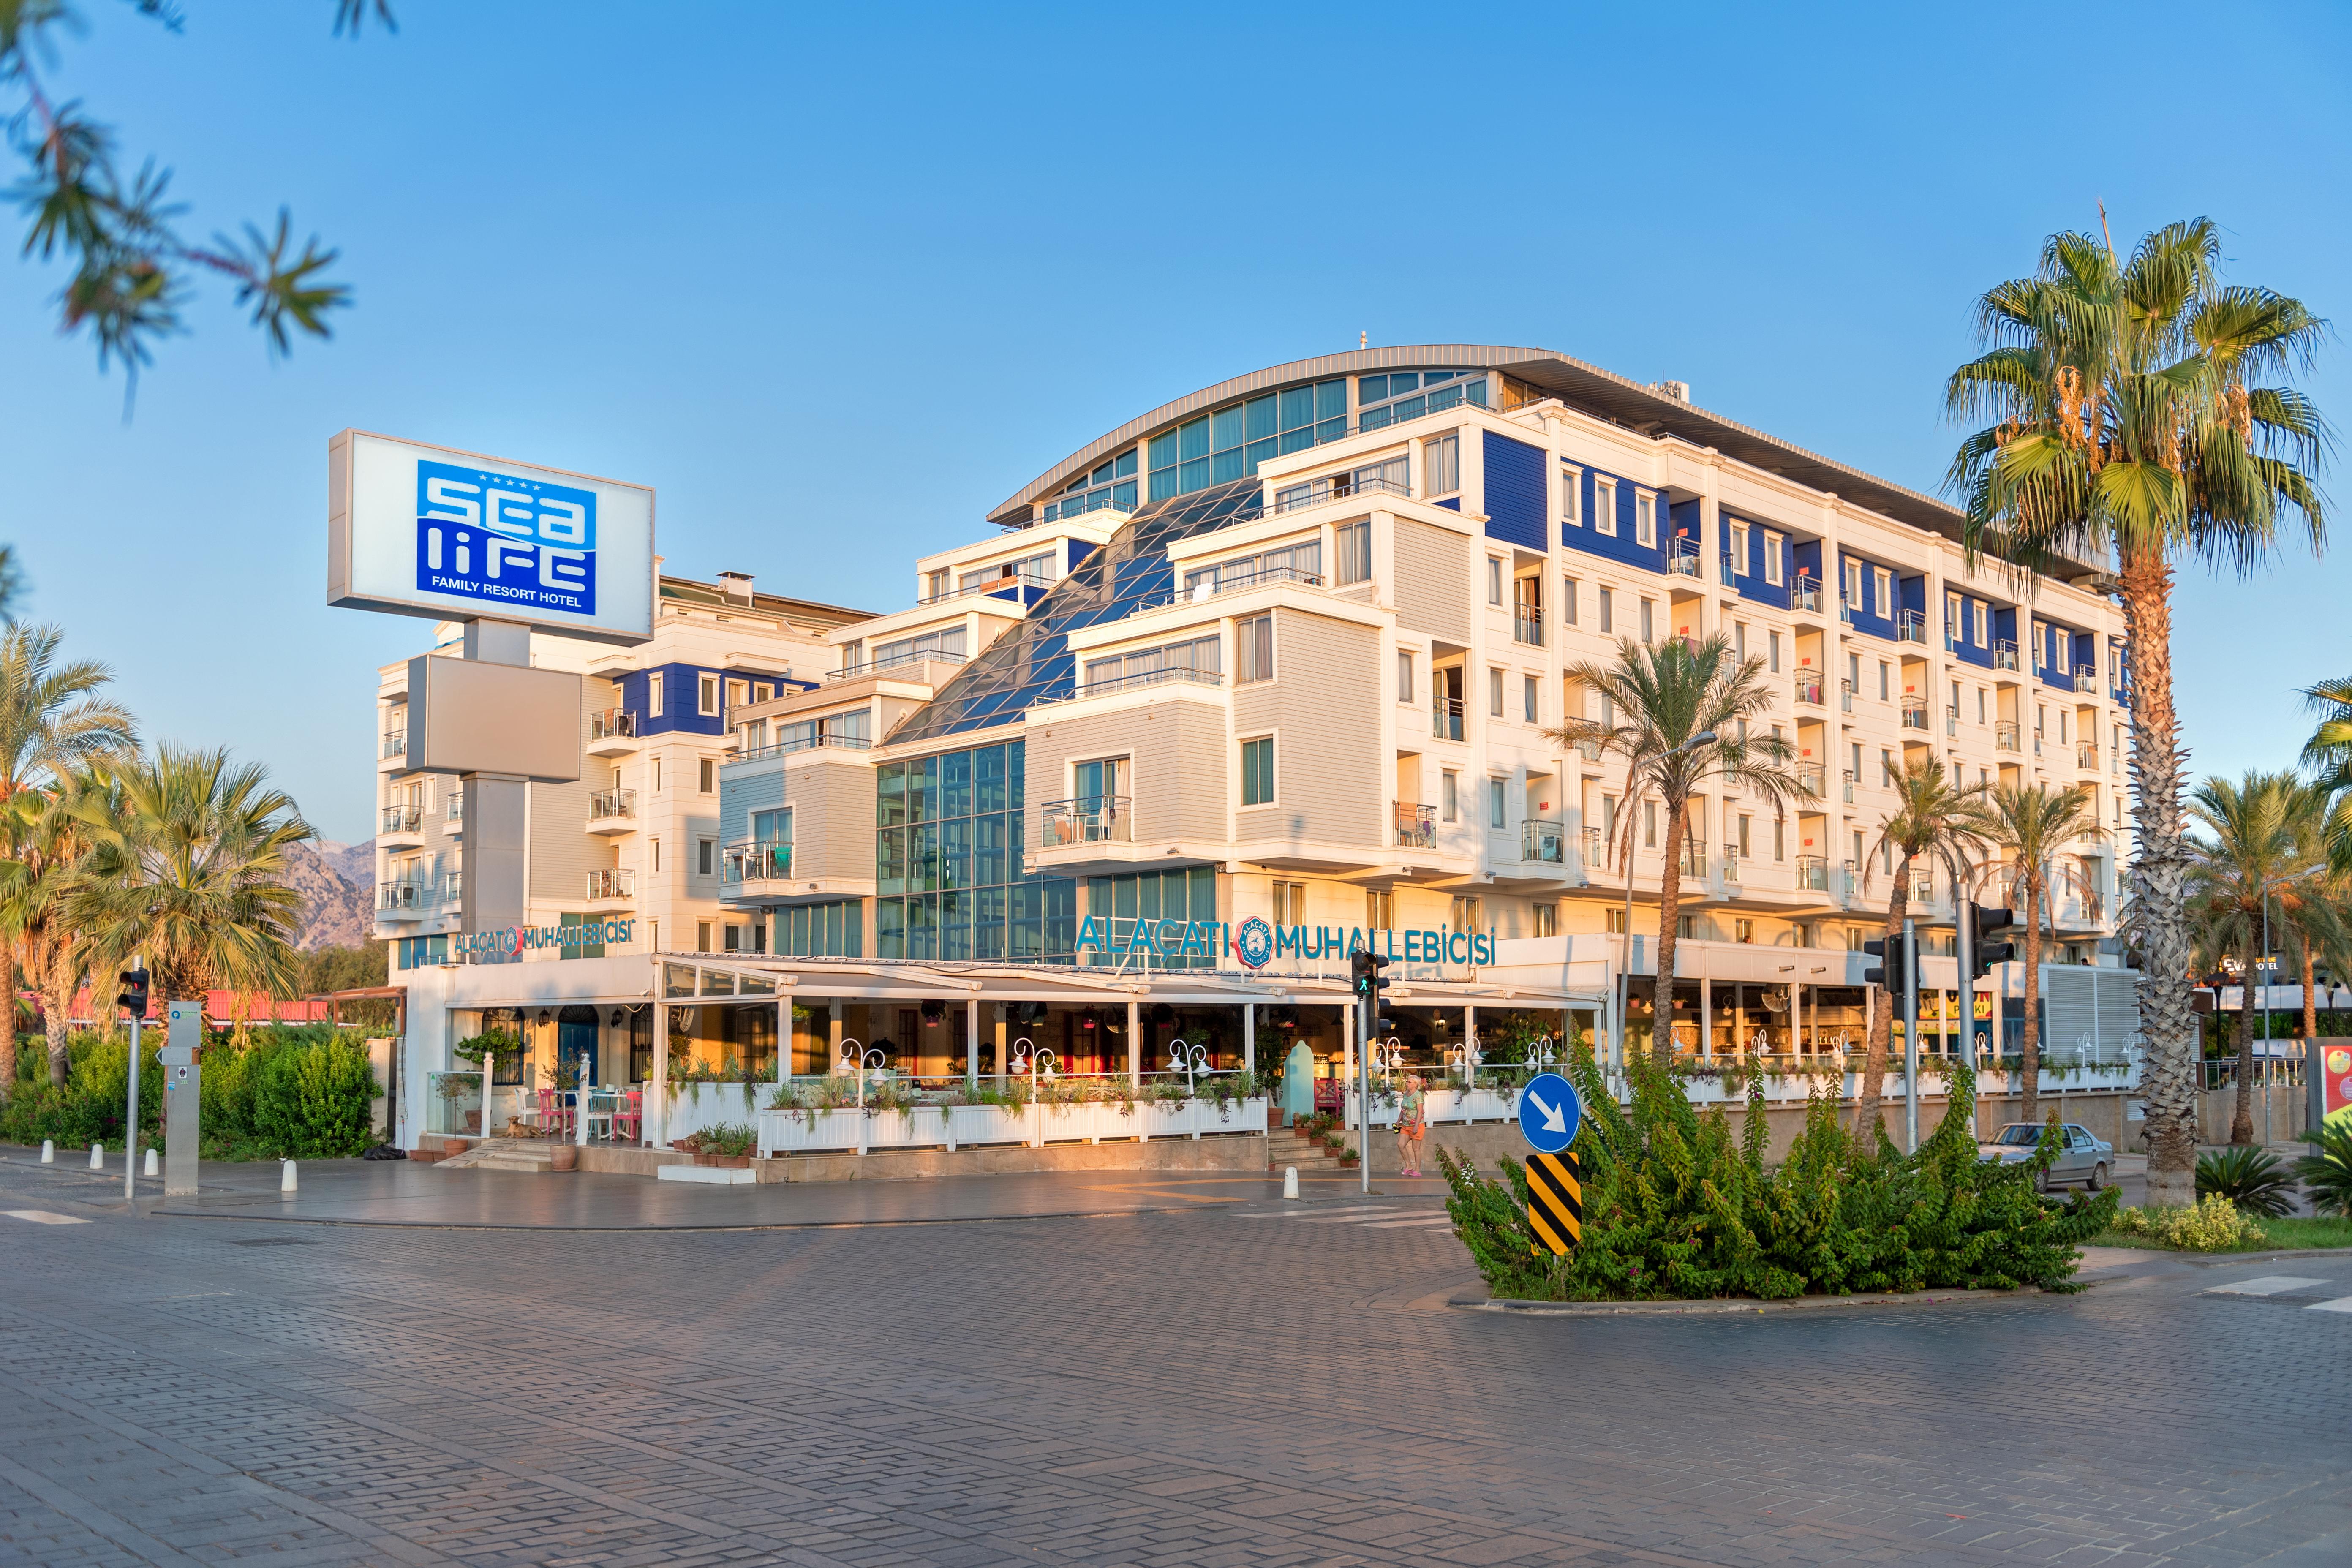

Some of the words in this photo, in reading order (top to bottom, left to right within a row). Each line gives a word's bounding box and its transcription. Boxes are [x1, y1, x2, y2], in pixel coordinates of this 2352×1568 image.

[432, 576, 479, 591] FAMILY
[484, 584, 536, 600] RESORT
[540, 593, 581, 607] HOTEL
[1075, 914, 1229, 964] ALAÇATI
[1243, 921, 1269, 936] ALAÇATI
[454, 931, 504, 956] ALAÇAT
[1954, 1005, 1984, 1014] PKI
